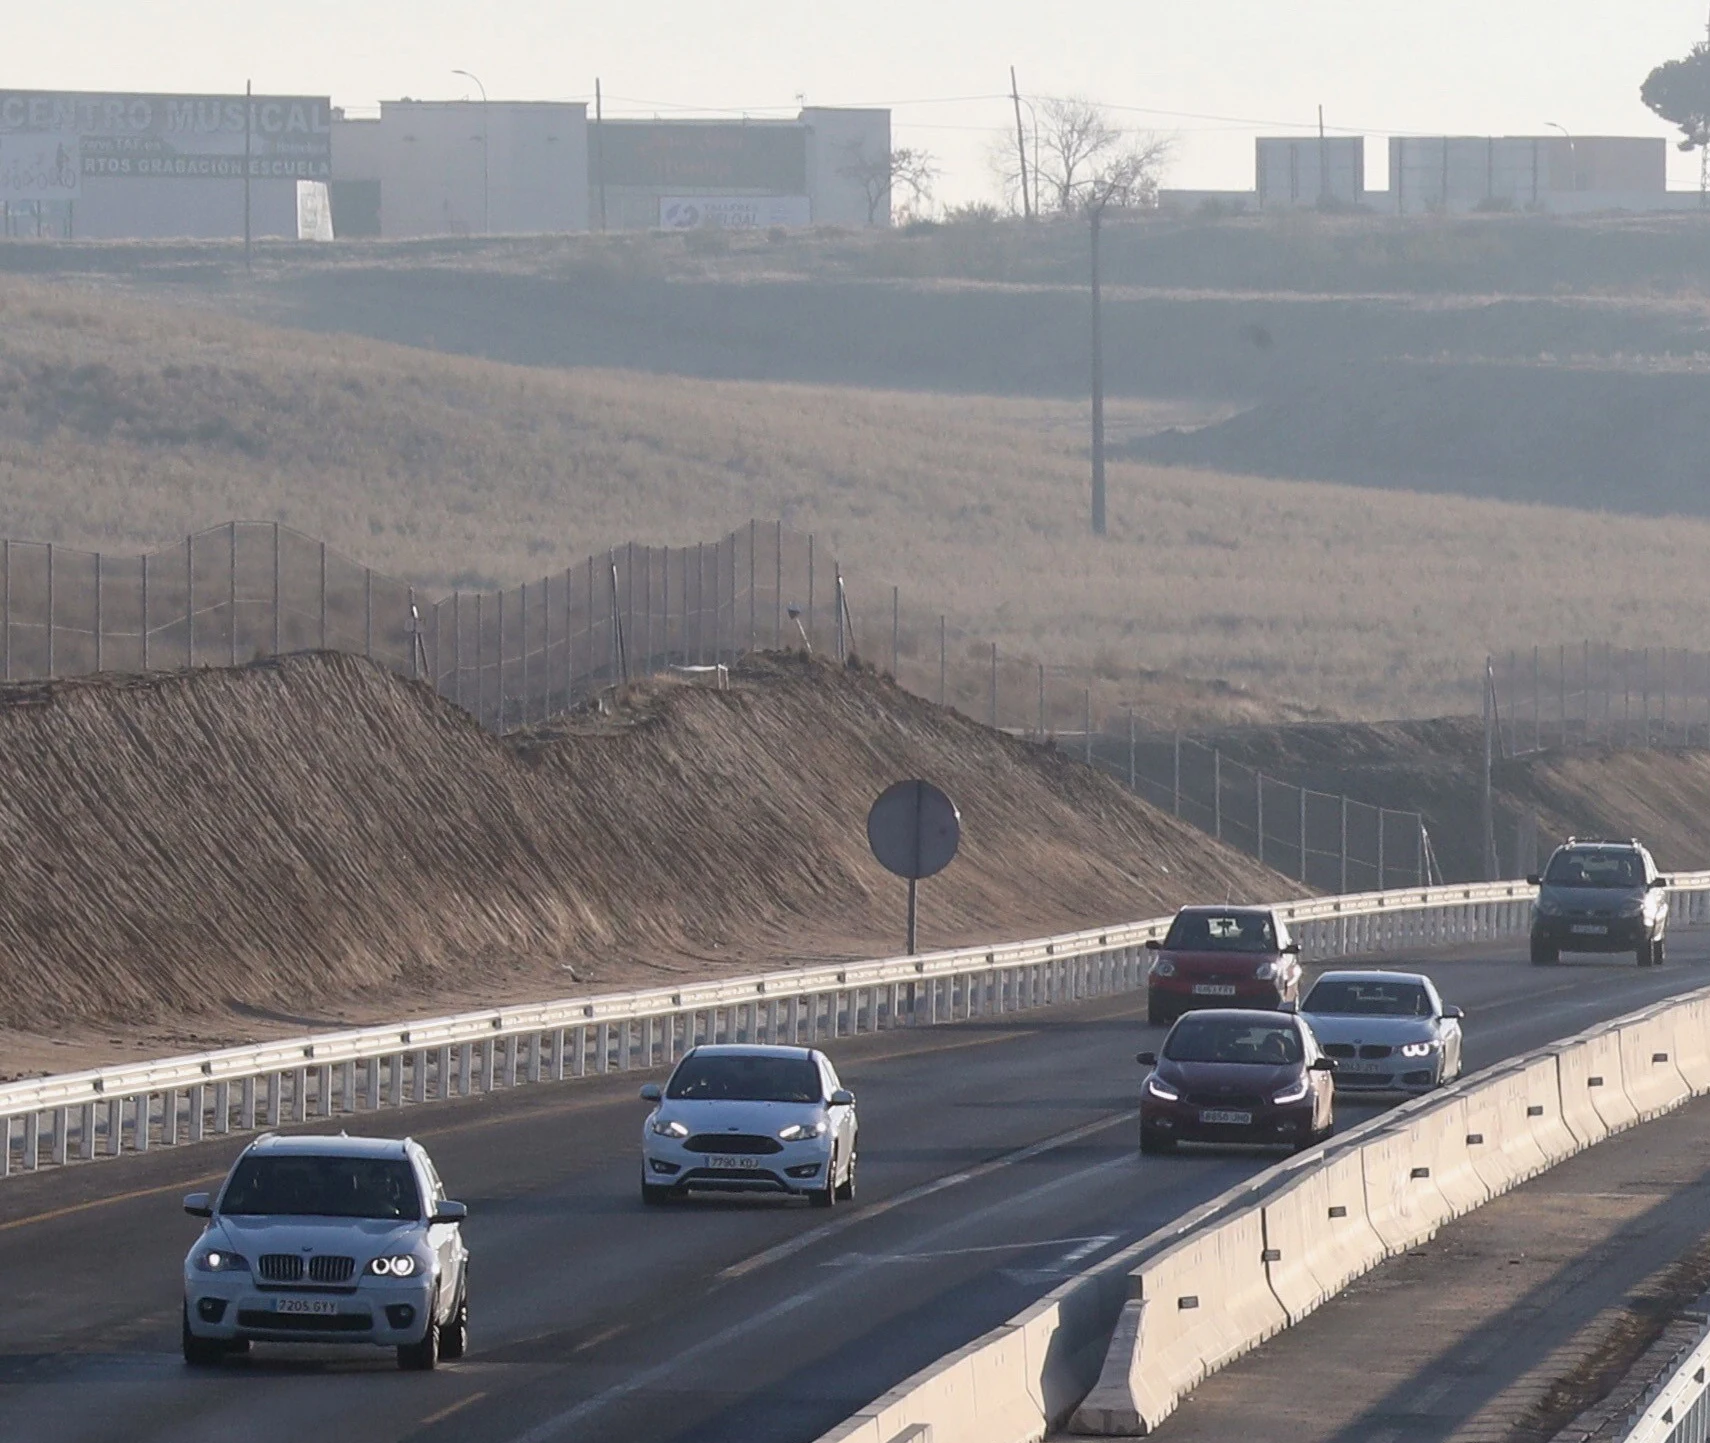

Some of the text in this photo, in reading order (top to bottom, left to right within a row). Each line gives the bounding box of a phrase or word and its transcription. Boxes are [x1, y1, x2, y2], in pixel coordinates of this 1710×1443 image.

[2, 97, 330, 135] CENTRO MUSICAL
[249, 160, 330, 176] ESCUELA
